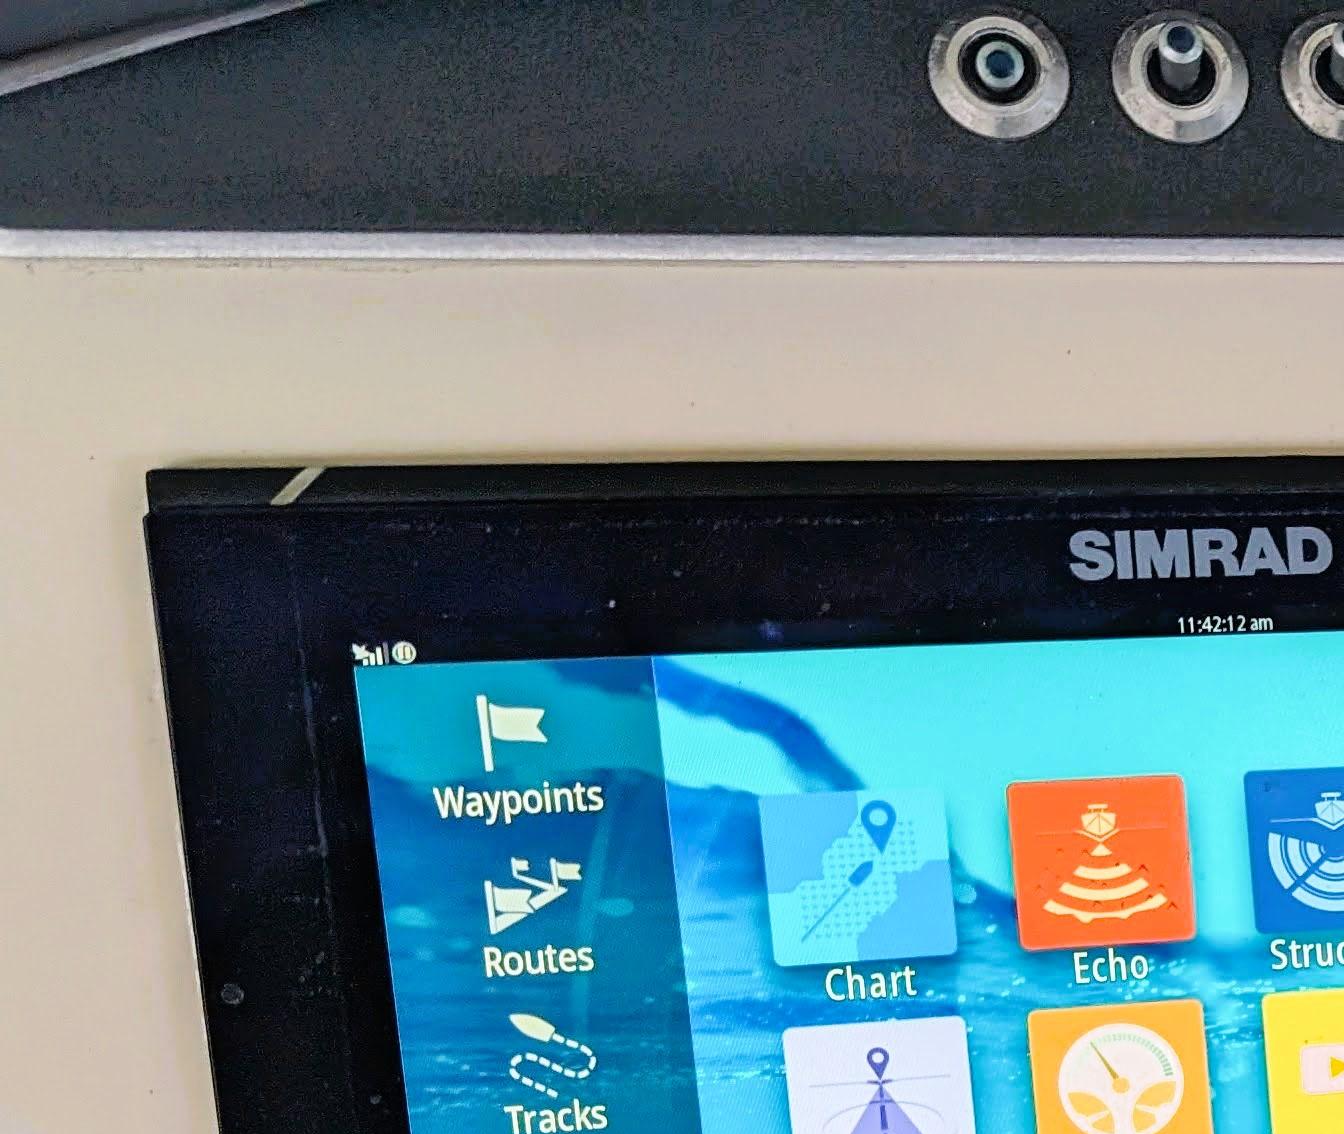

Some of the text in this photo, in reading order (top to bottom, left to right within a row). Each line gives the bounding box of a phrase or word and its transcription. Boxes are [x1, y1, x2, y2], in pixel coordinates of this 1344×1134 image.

[1069, 526, 1333, 581] SIMRAD
[1177, 614, 1273, 634] 11:42:12 am
[433, 782, 604, 825] Waypoints
[484, 945, 594, 978] Routes
[1073, 948, 1149, 984] Echo
[825, 964, 917, 1001] Chart
